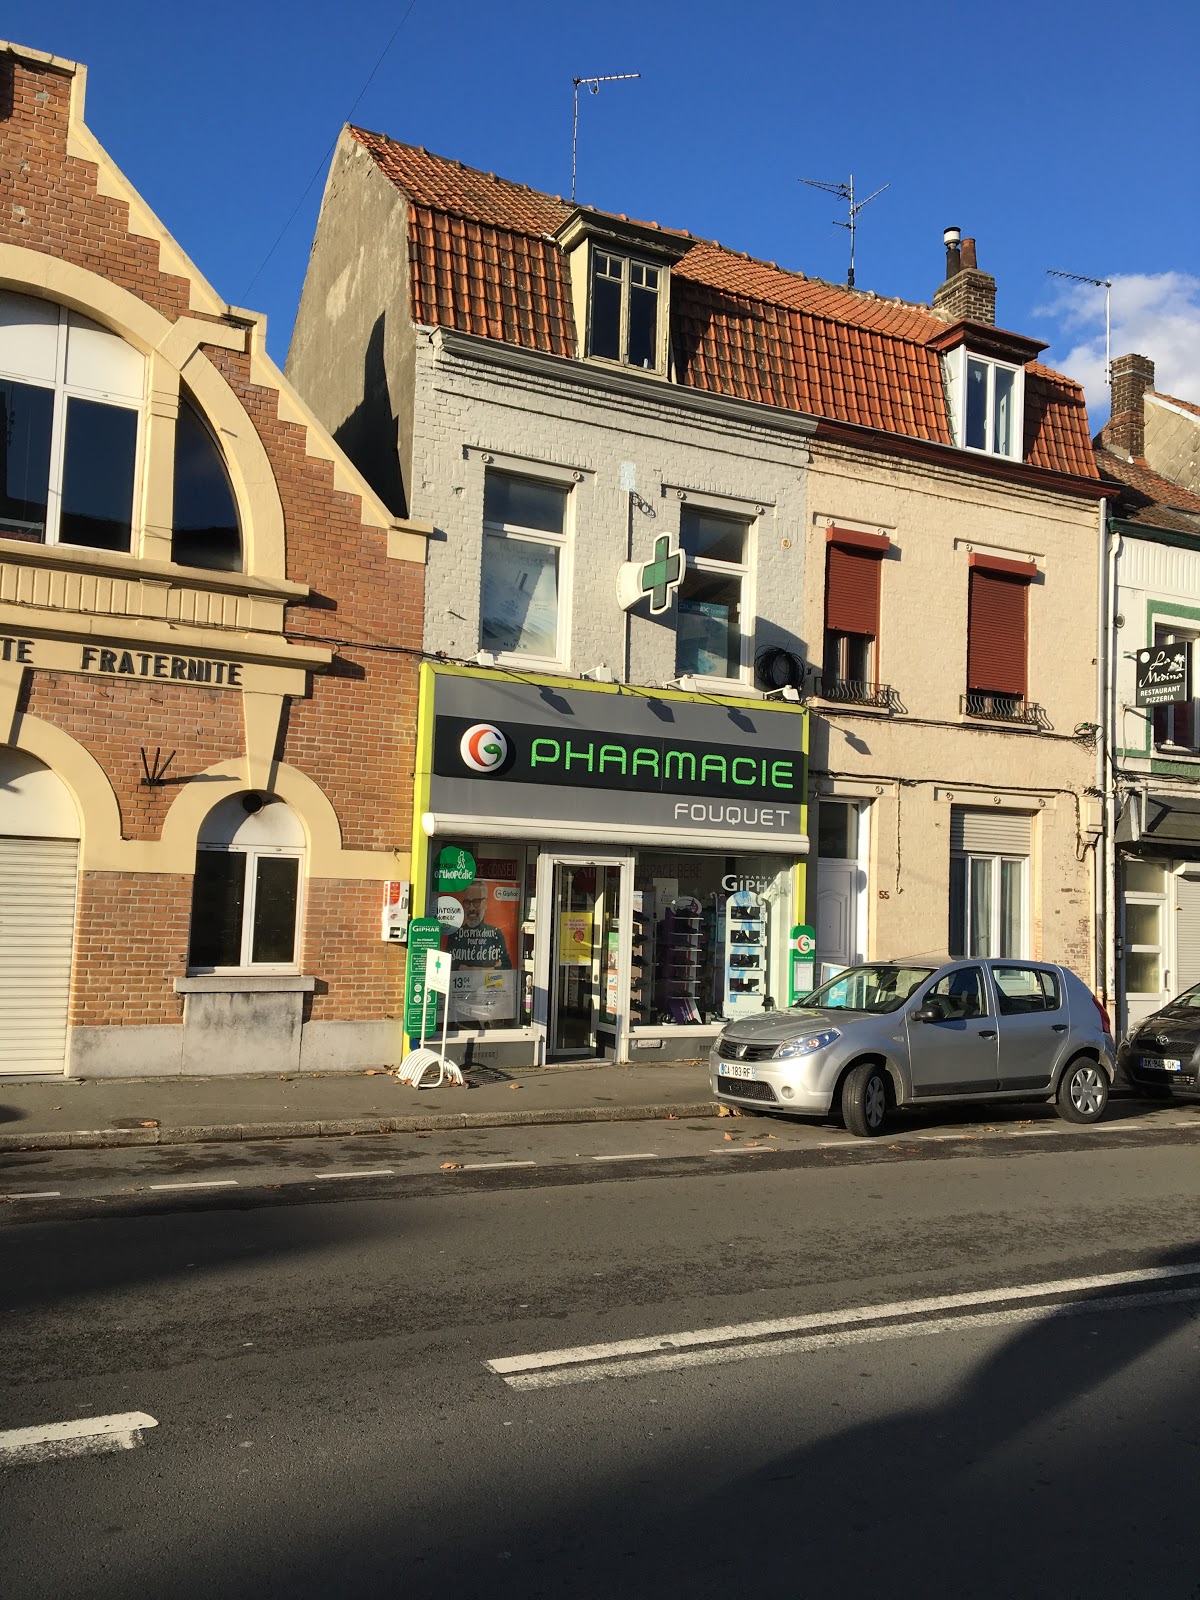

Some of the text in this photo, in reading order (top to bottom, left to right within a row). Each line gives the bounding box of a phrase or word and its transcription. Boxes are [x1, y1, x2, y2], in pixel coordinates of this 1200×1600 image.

[503, 641, 528, 649] NUXE
[81, 647, 243, 685] FRATERNITE
[1149, 650, 1170, 670] La
[1139, 670, 1183, 687] Medina
[1140, 685, 1181, 697] RESTAURANT
[1146, 695, 1175, 703] PIZZERIA
[531, 738, 793, 789] PHARMACIE
[674, 803, 790, 826] FOUQUET
[879, 890, 890, 899] 55
[459, 927, 470, 938] Des
[452, 945, 501, 960] santé de fer
[453, 977, 463, 988] 13
